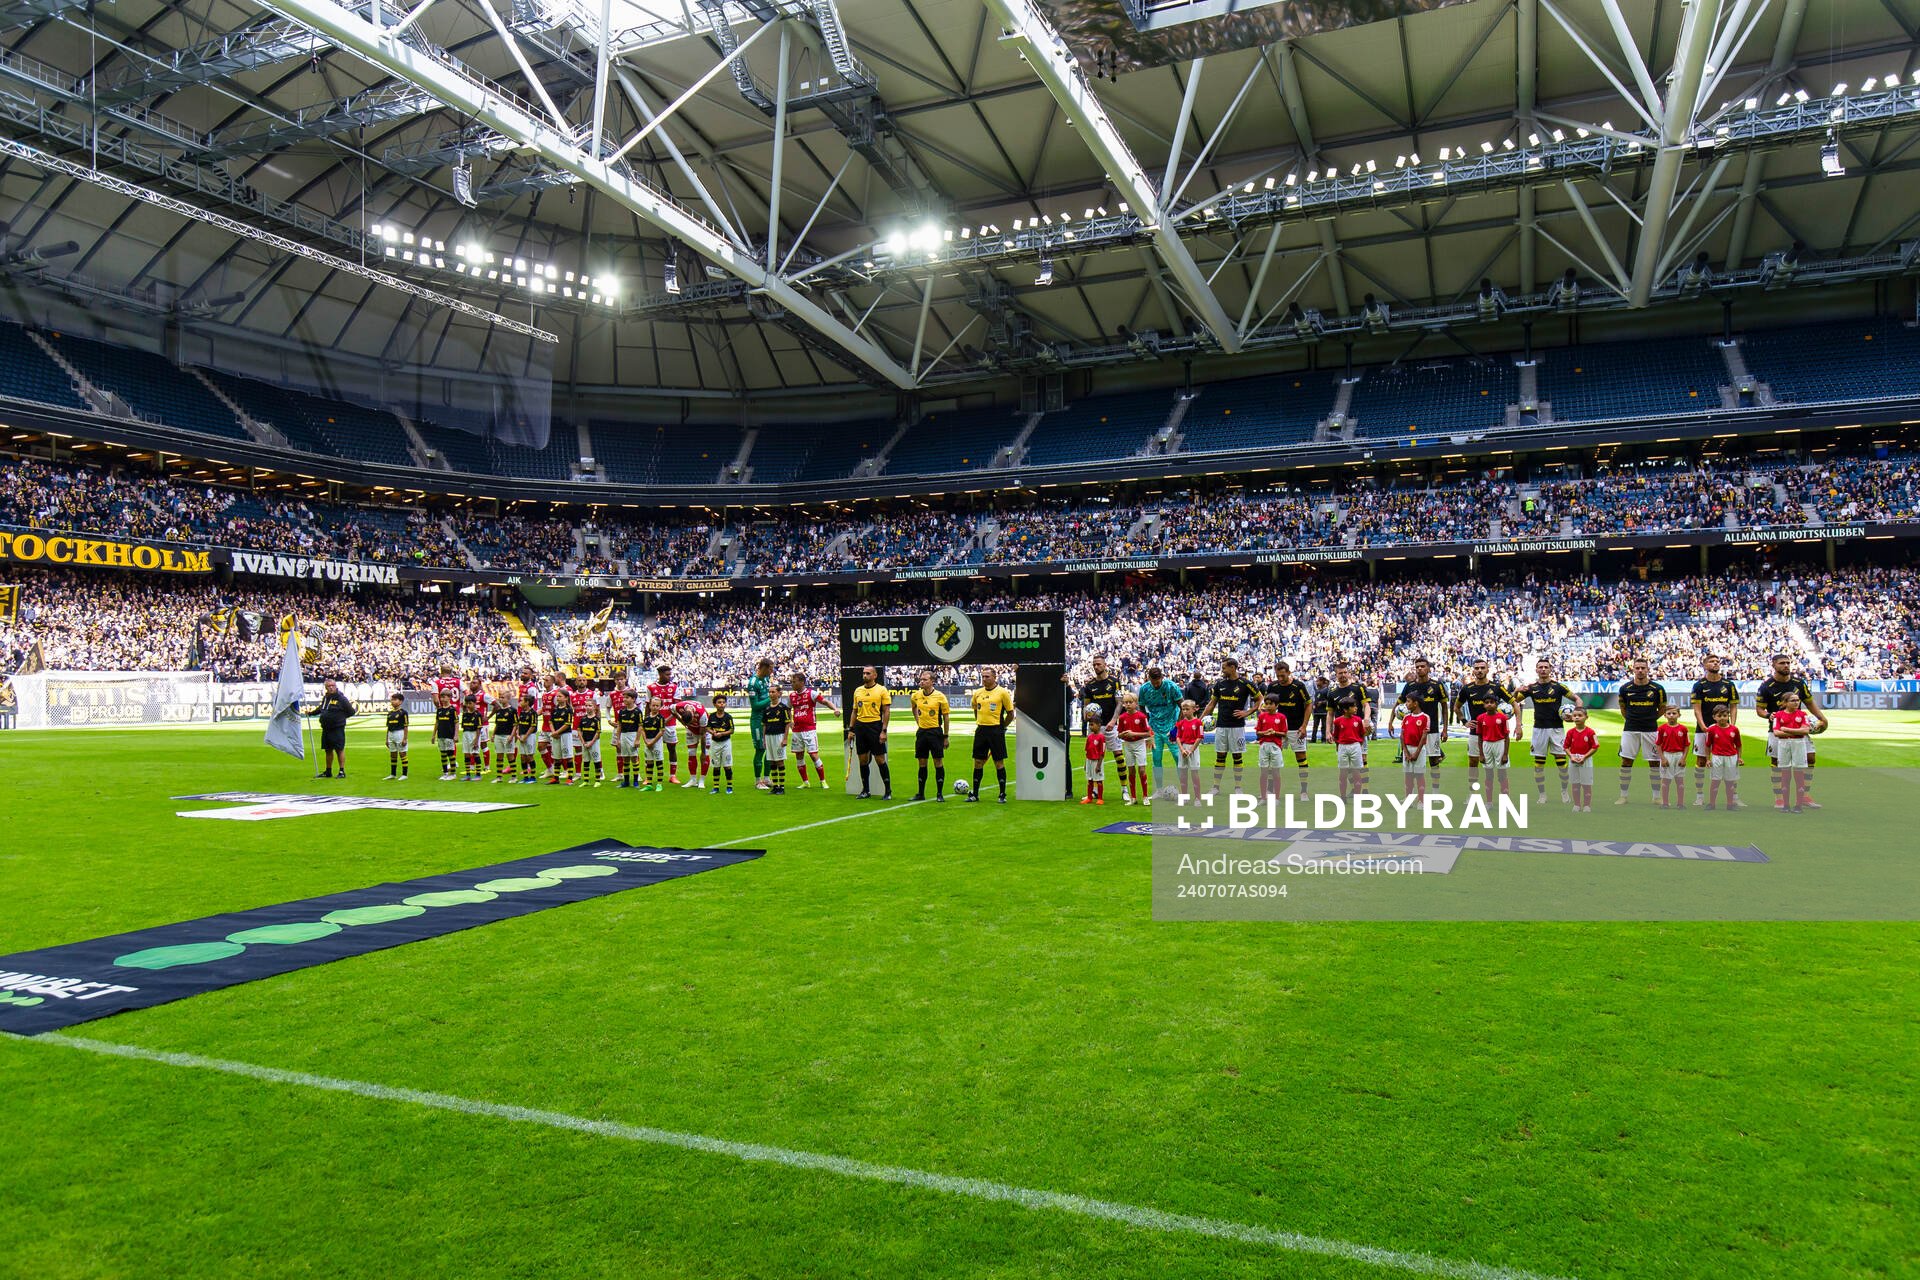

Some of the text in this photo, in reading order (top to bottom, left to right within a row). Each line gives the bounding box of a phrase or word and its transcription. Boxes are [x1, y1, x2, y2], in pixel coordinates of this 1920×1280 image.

[1724, 527, 1865, 543] ALLMÄNNA IDROTTSKLUBBEN
[1474, 539, 1596, 553] ALLMÄNNA IDROTTSKLUBBEN
[1256, 550, 1363, 563] ALLMÄNNA IDROTTSKLUBBEN
[232, 552, 399, 584] IVAN TURINA
[1064, 560, 1159, 572] ALLMÄNNA IDROTTSKLUBBEN
[895, 568, 979, 579] ALLMÄNNA IDROTTSKLUBBEN
[507, 576, 521, 584] AIK
[574, 578, 599, 587] 00:00
[638, 580, 730, 590] TYRESÖ GNAGARE
[851, 627, 910, 643] UNIBET
[986, 623, 1051, 639] UNIBET
[411, 701, 438, 713] UNI
[1823, 694, 1900, 709] UNIBET
[1032, 746, 1049, 769] U
[1202, 826, 1737, 860] ALLSVENSKAN
